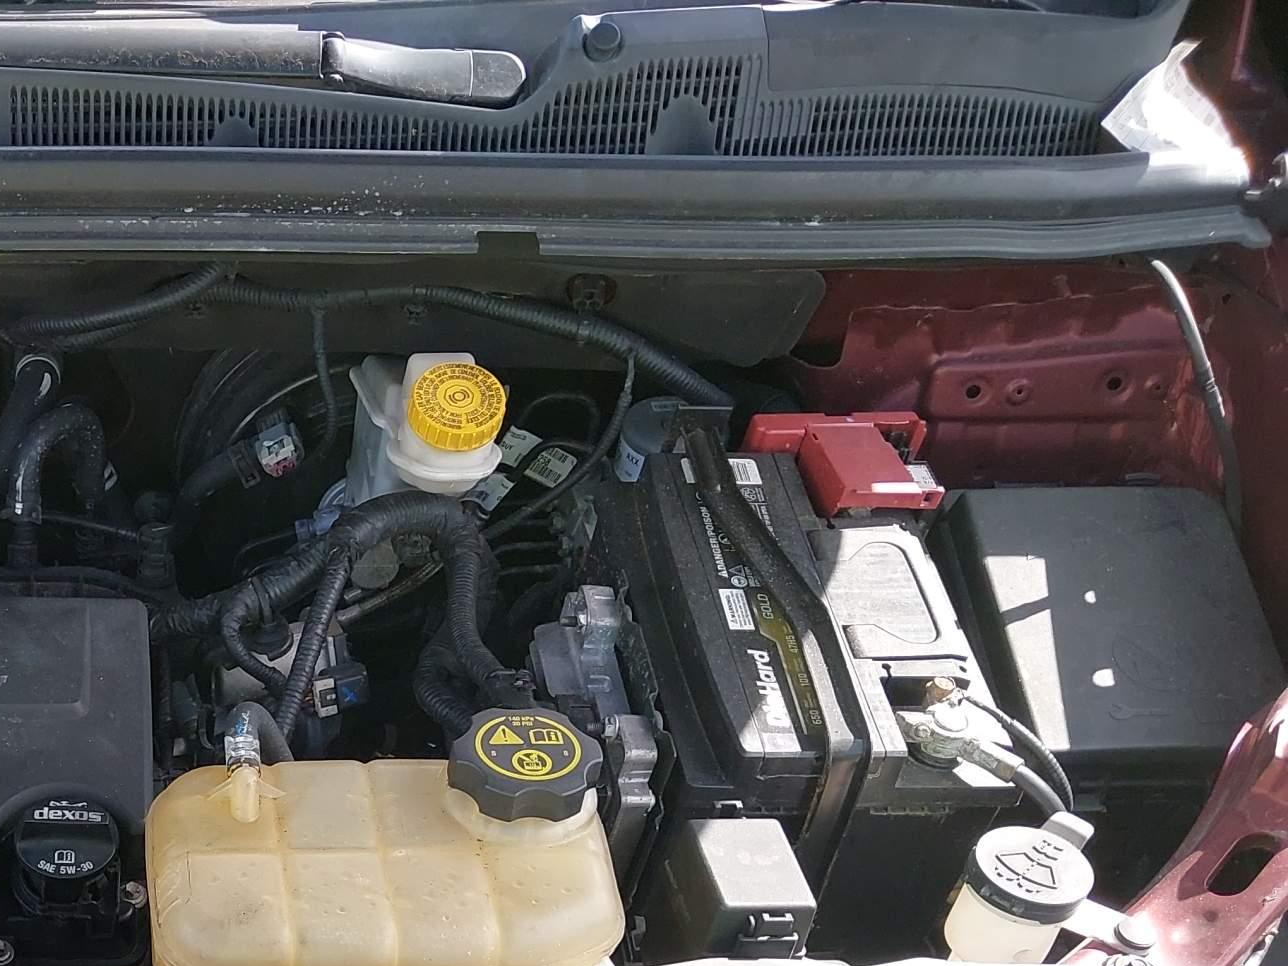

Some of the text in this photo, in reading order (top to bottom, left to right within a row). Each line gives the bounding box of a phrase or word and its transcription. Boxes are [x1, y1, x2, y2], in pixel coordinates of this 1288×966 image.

[756, 593, 774, 620] GOLD
[797, 672, 811, 687] 100
[808, 708, 823, 726] 650
[33, 807, 105, 822] dexos
[37, 859, 94, 875] SAE 5W-30
